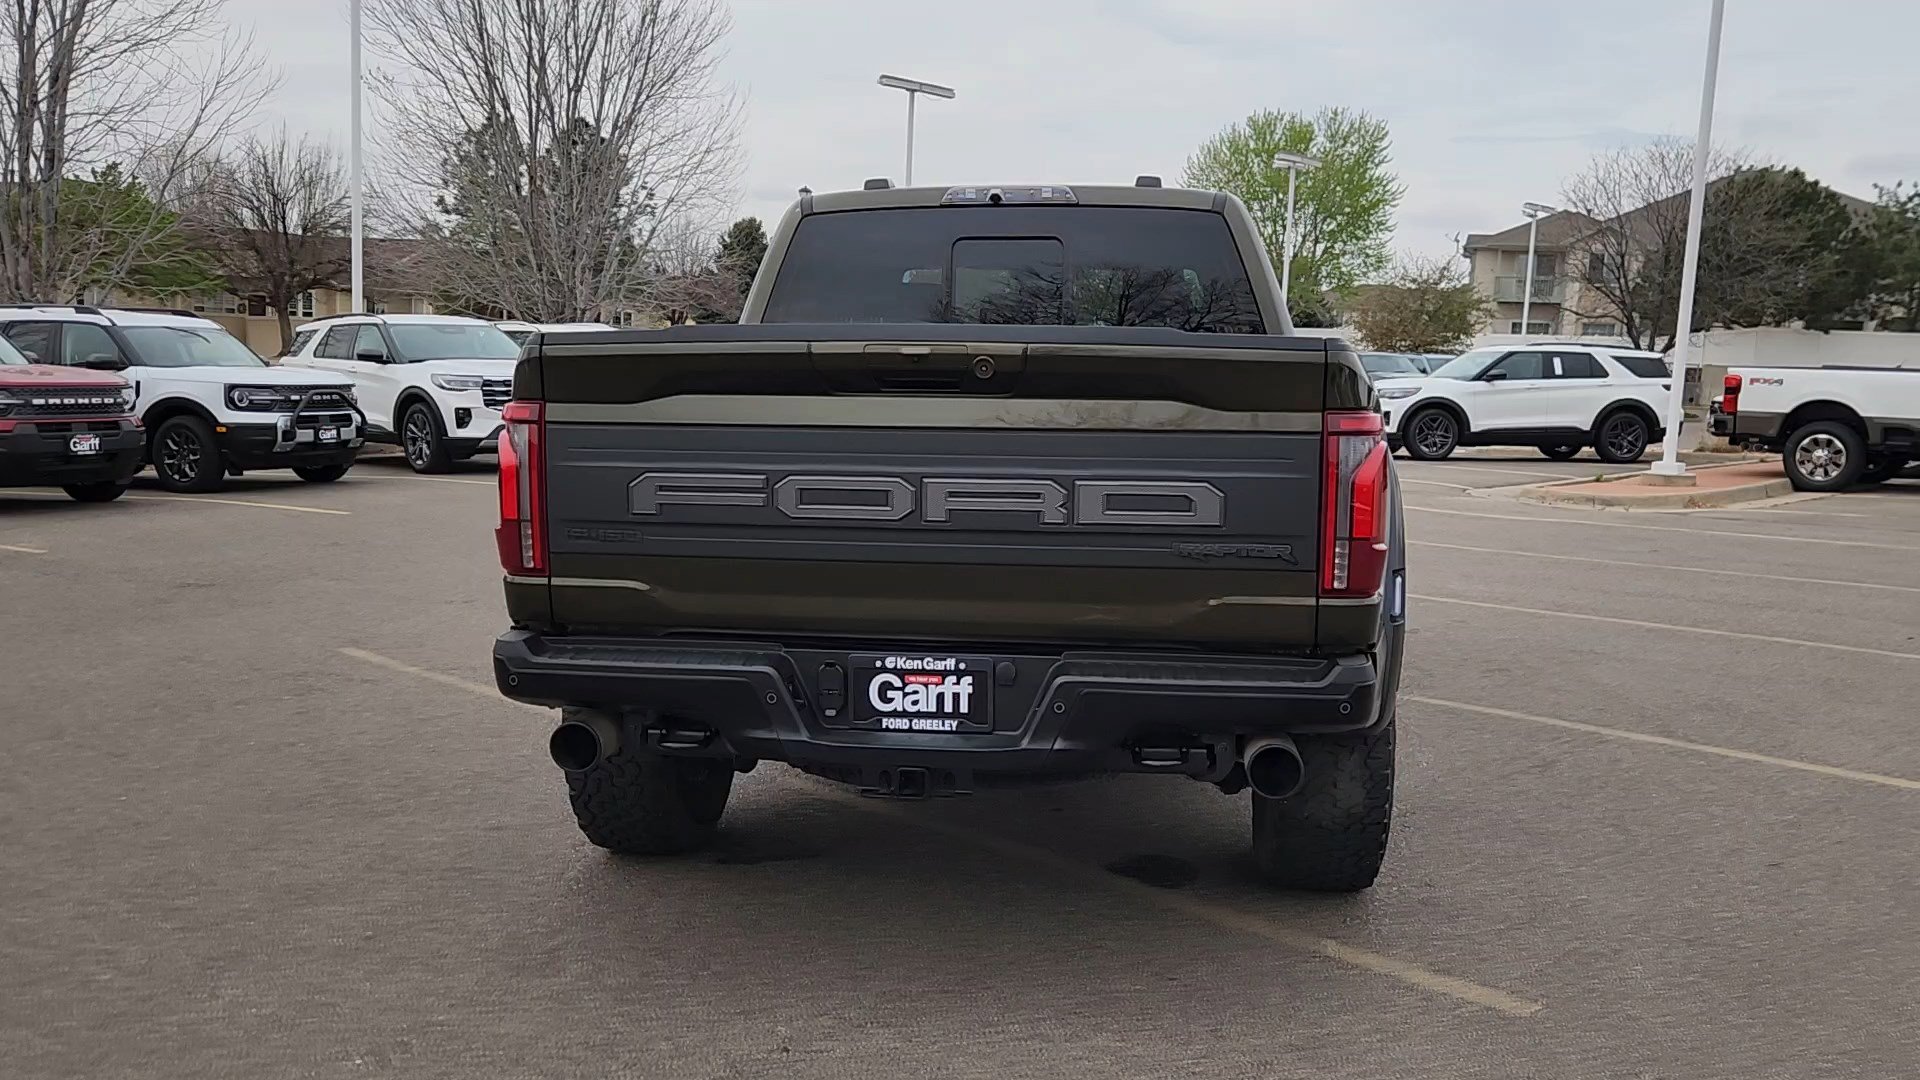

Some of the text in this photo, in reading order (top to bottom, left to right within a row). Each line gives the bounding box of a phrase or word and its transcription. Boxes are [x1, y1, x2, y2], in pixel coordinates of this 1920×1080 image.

[69, 437, 100, 452] Garff
[627, 472, 1227, 529] FORD
[1171, 542, 1299, 566] RAPTOR
[897, 656, 956, 670] Ken Garff
[868, 672, 974, 714] Garff
[881, 718, 958, 731] FORD GREELEY
